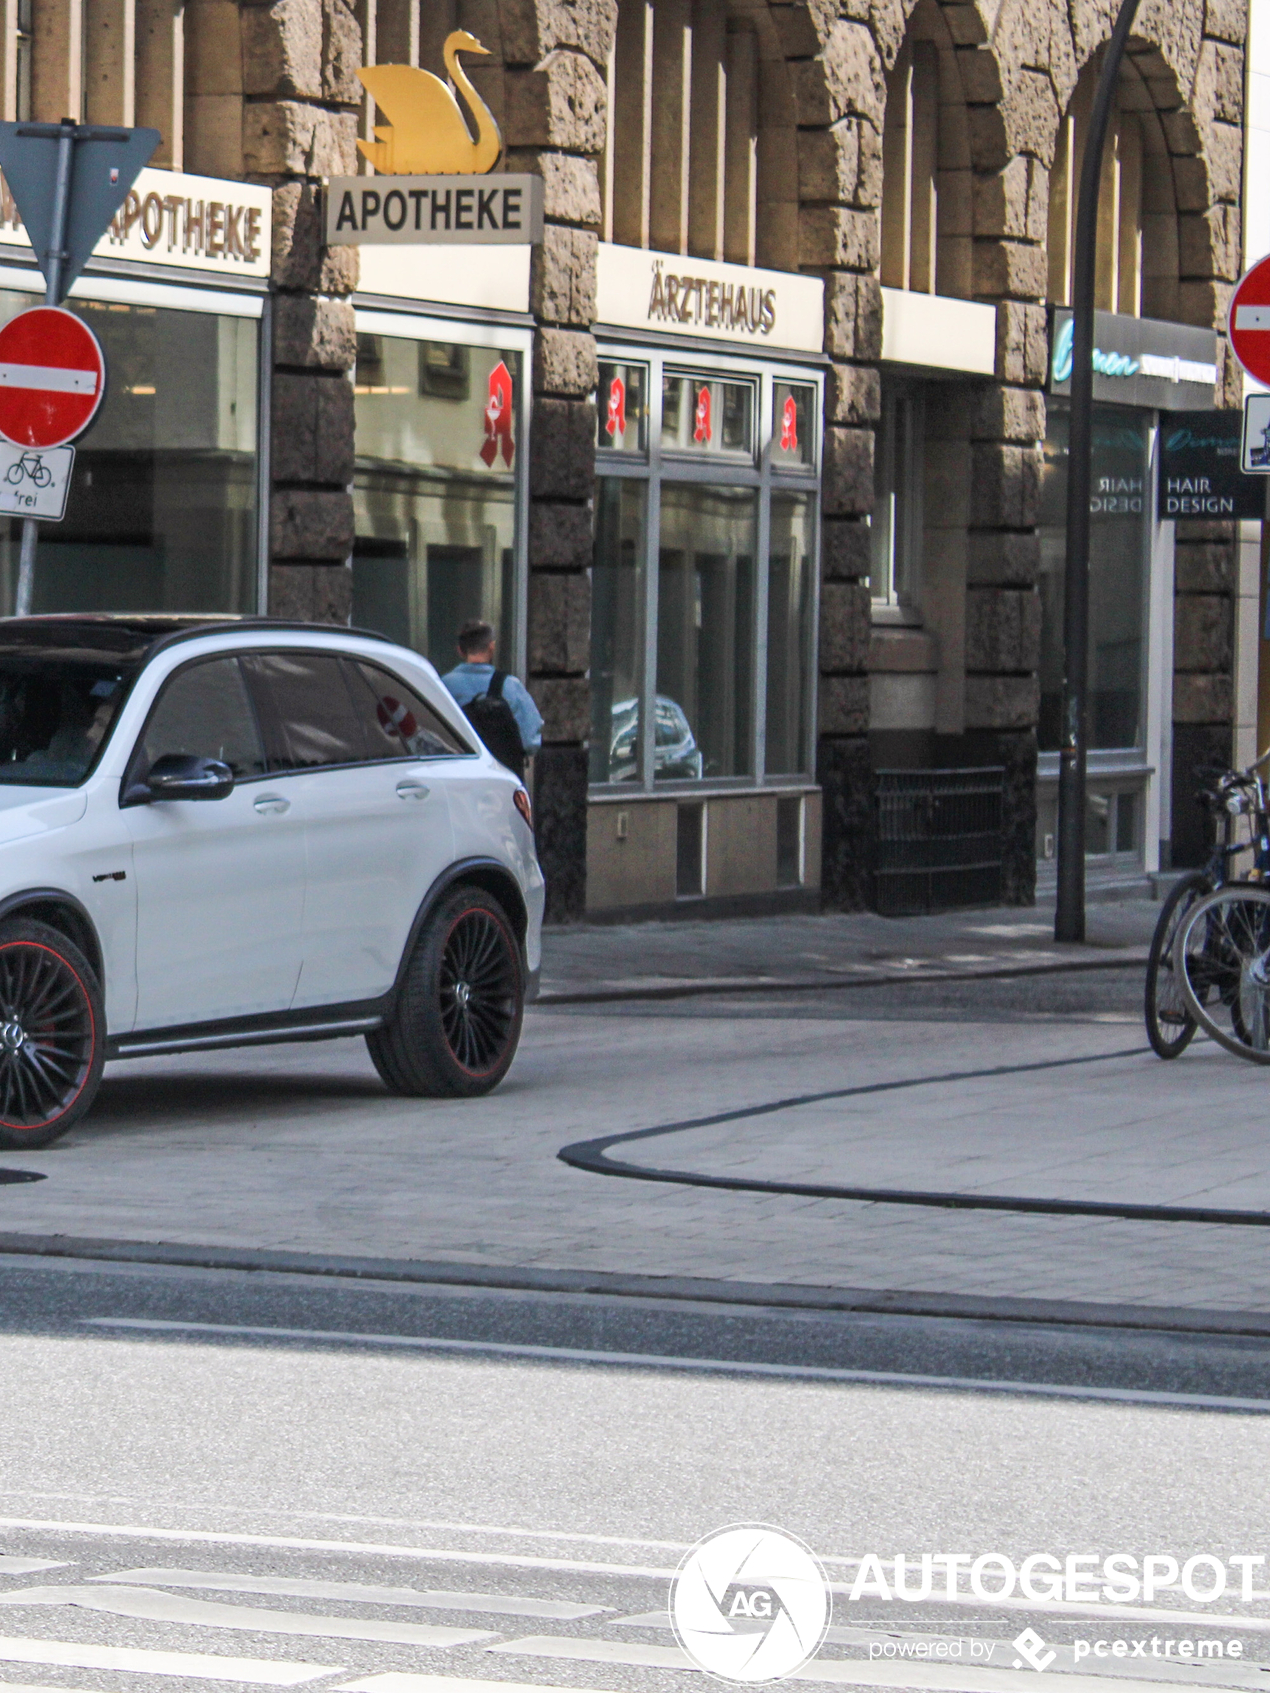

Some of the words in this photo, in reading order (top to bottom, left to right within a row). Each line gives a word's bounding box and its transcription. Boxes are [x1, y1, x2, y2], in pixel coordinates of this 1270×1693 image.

[109, 188, 262, 264] POTHEKE
[335, 188, 523, 231] APOTHEKE
[647, 259, 777, 336] ÄRZTEHAUS
[1167, 476, 1211, 493] HAIR
[1167, 497, 1234, 513] DESIGN
